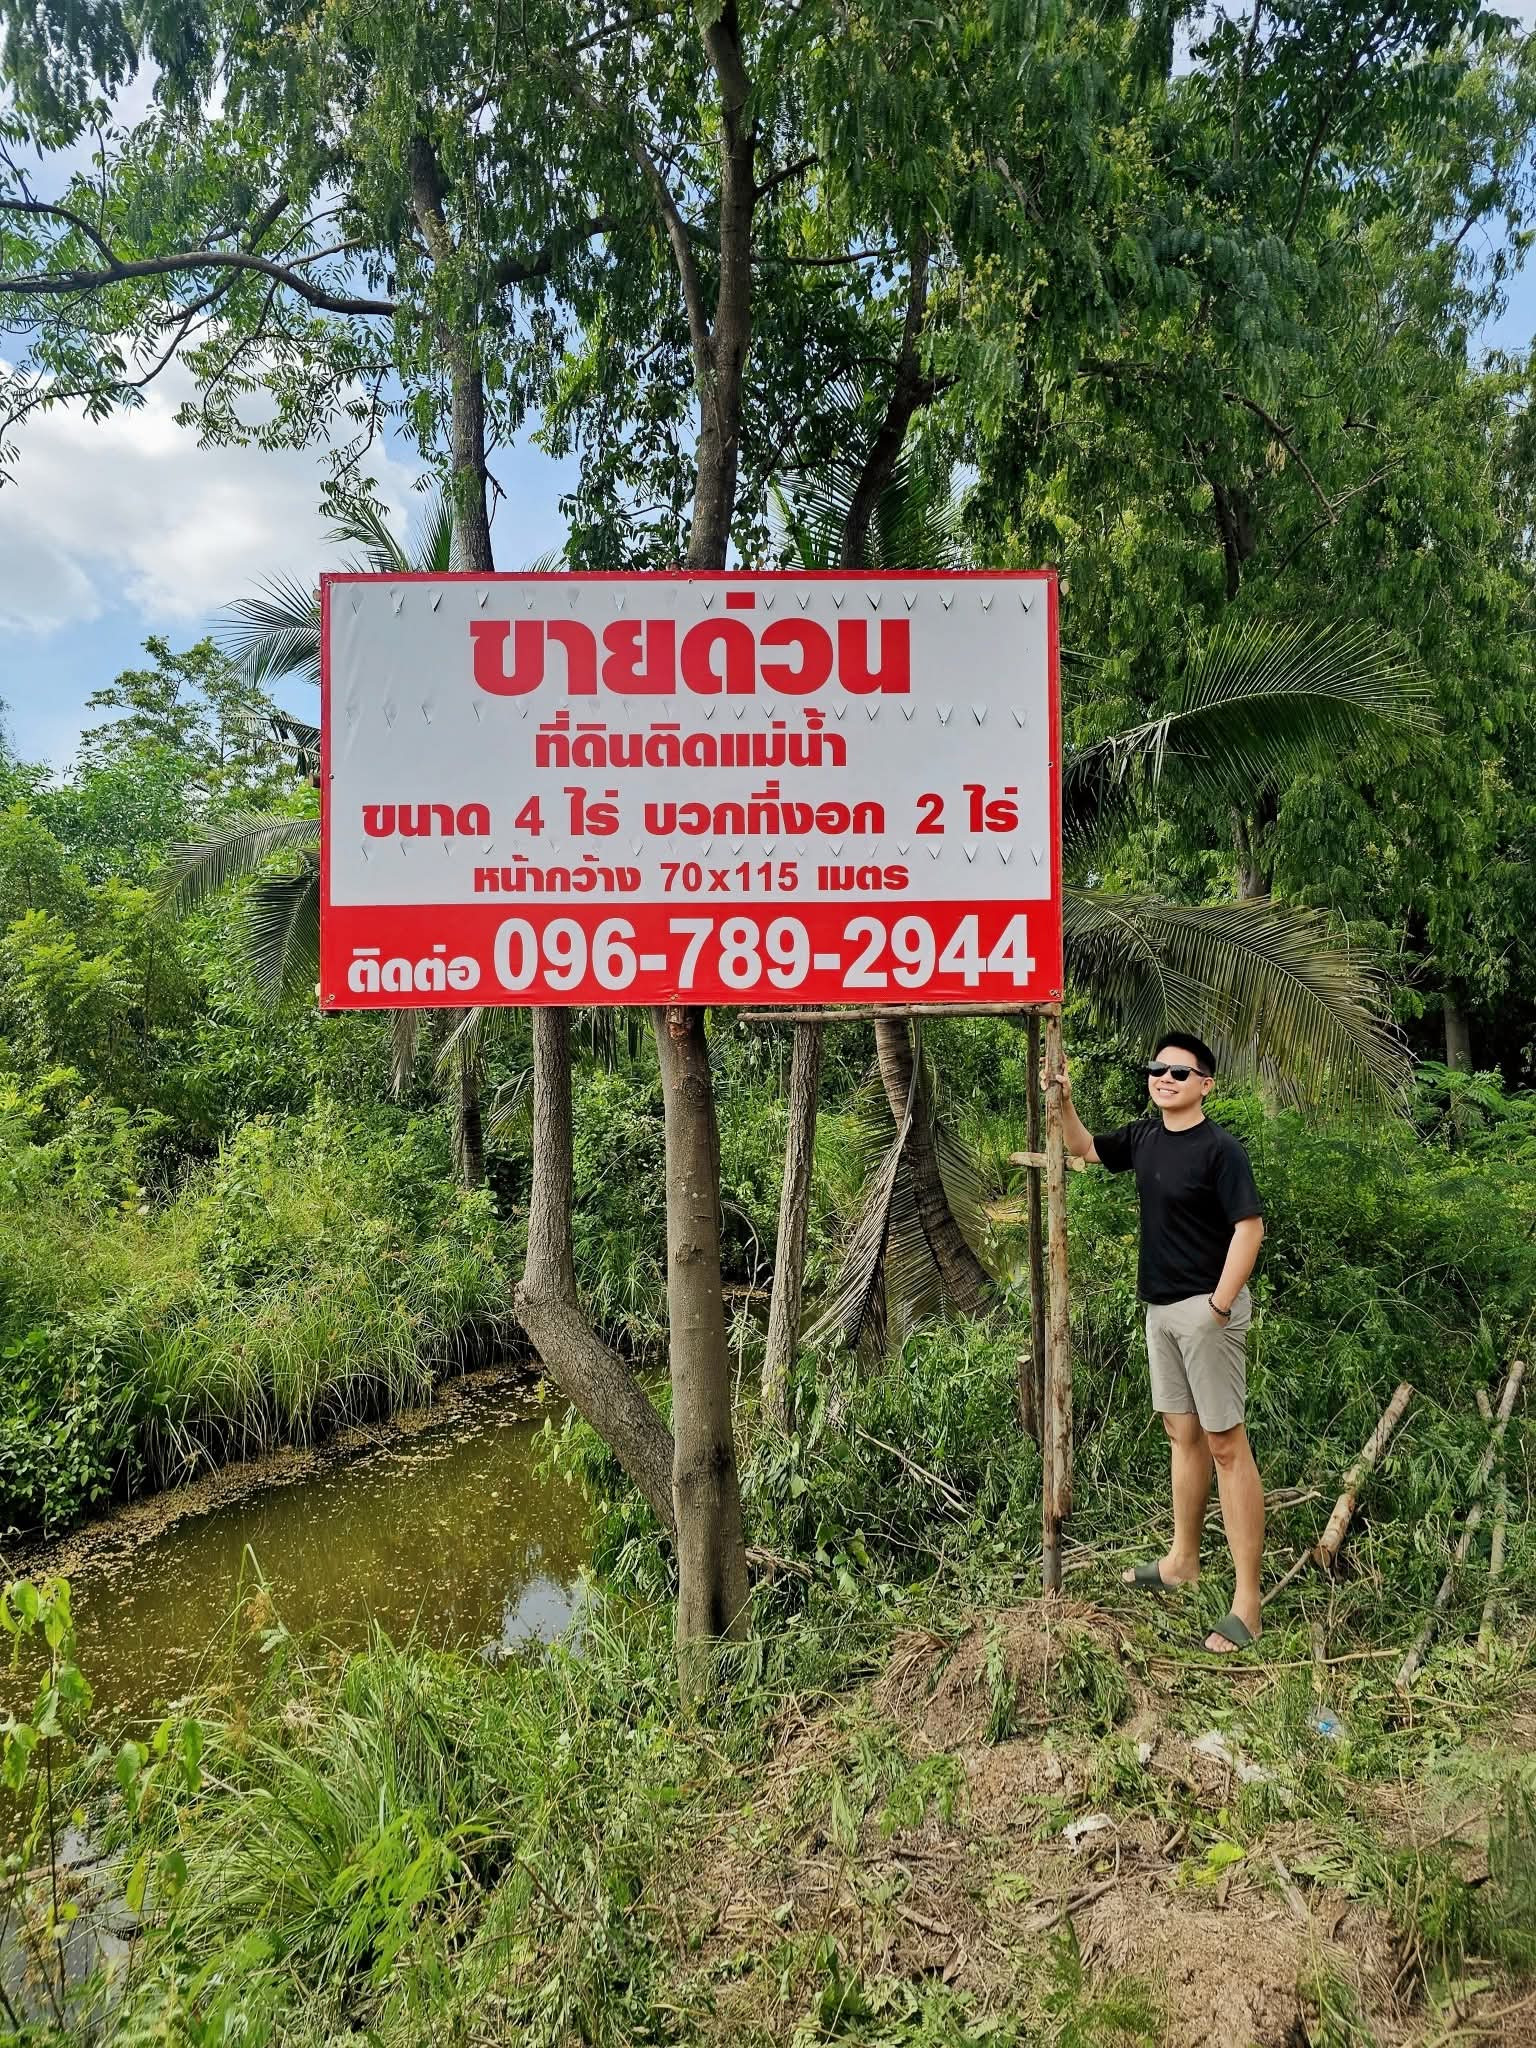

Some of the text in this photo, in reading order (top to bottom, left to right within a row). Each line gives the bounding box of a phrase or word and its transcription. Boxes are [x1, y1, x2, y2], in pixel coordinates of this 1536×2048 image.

[469, 591, 911, 697] ขายด่วน
[535, 707, 847, 768] ที่ดินติดแม่น้ำ
[362, 779, 1019, 837] ขนาด 4 ไร่ บวกที่งอก 2 ไร่
[473, 854, 910, 893] หน้ากว้าง 70x115 เมตร
[347, 914, 1036, 993] ติดต่อ 096-789-2944
